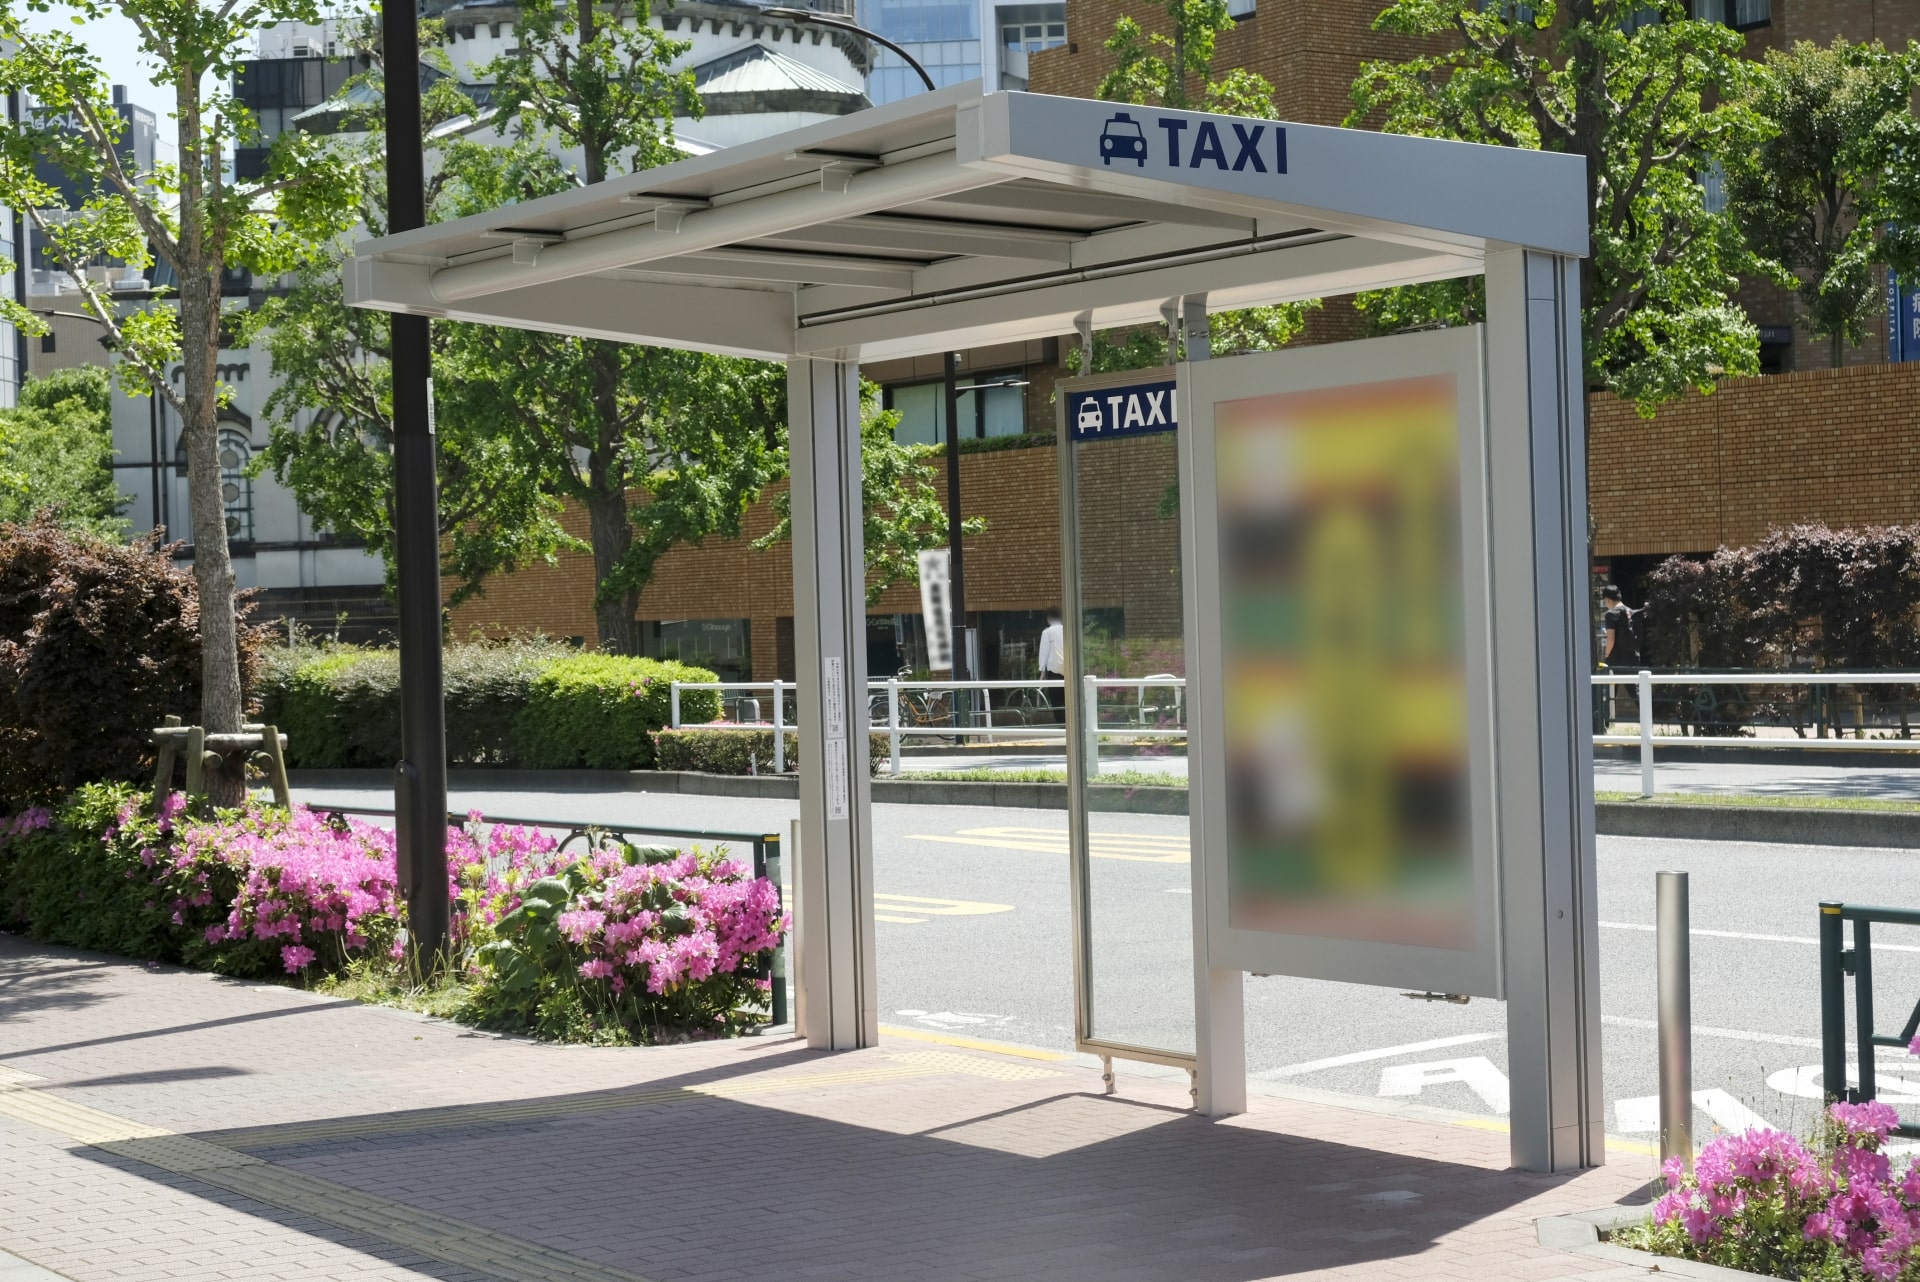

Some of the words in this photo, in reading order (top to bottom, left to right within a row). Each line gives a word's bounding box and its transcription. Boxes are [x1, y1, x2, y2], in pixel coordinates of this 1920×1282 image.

[1158, 117, 1288, 175] TAXI
[1888, 278, 1896, 341] HOSPITAL
[1107, 389, 1178, 430] TAXI
